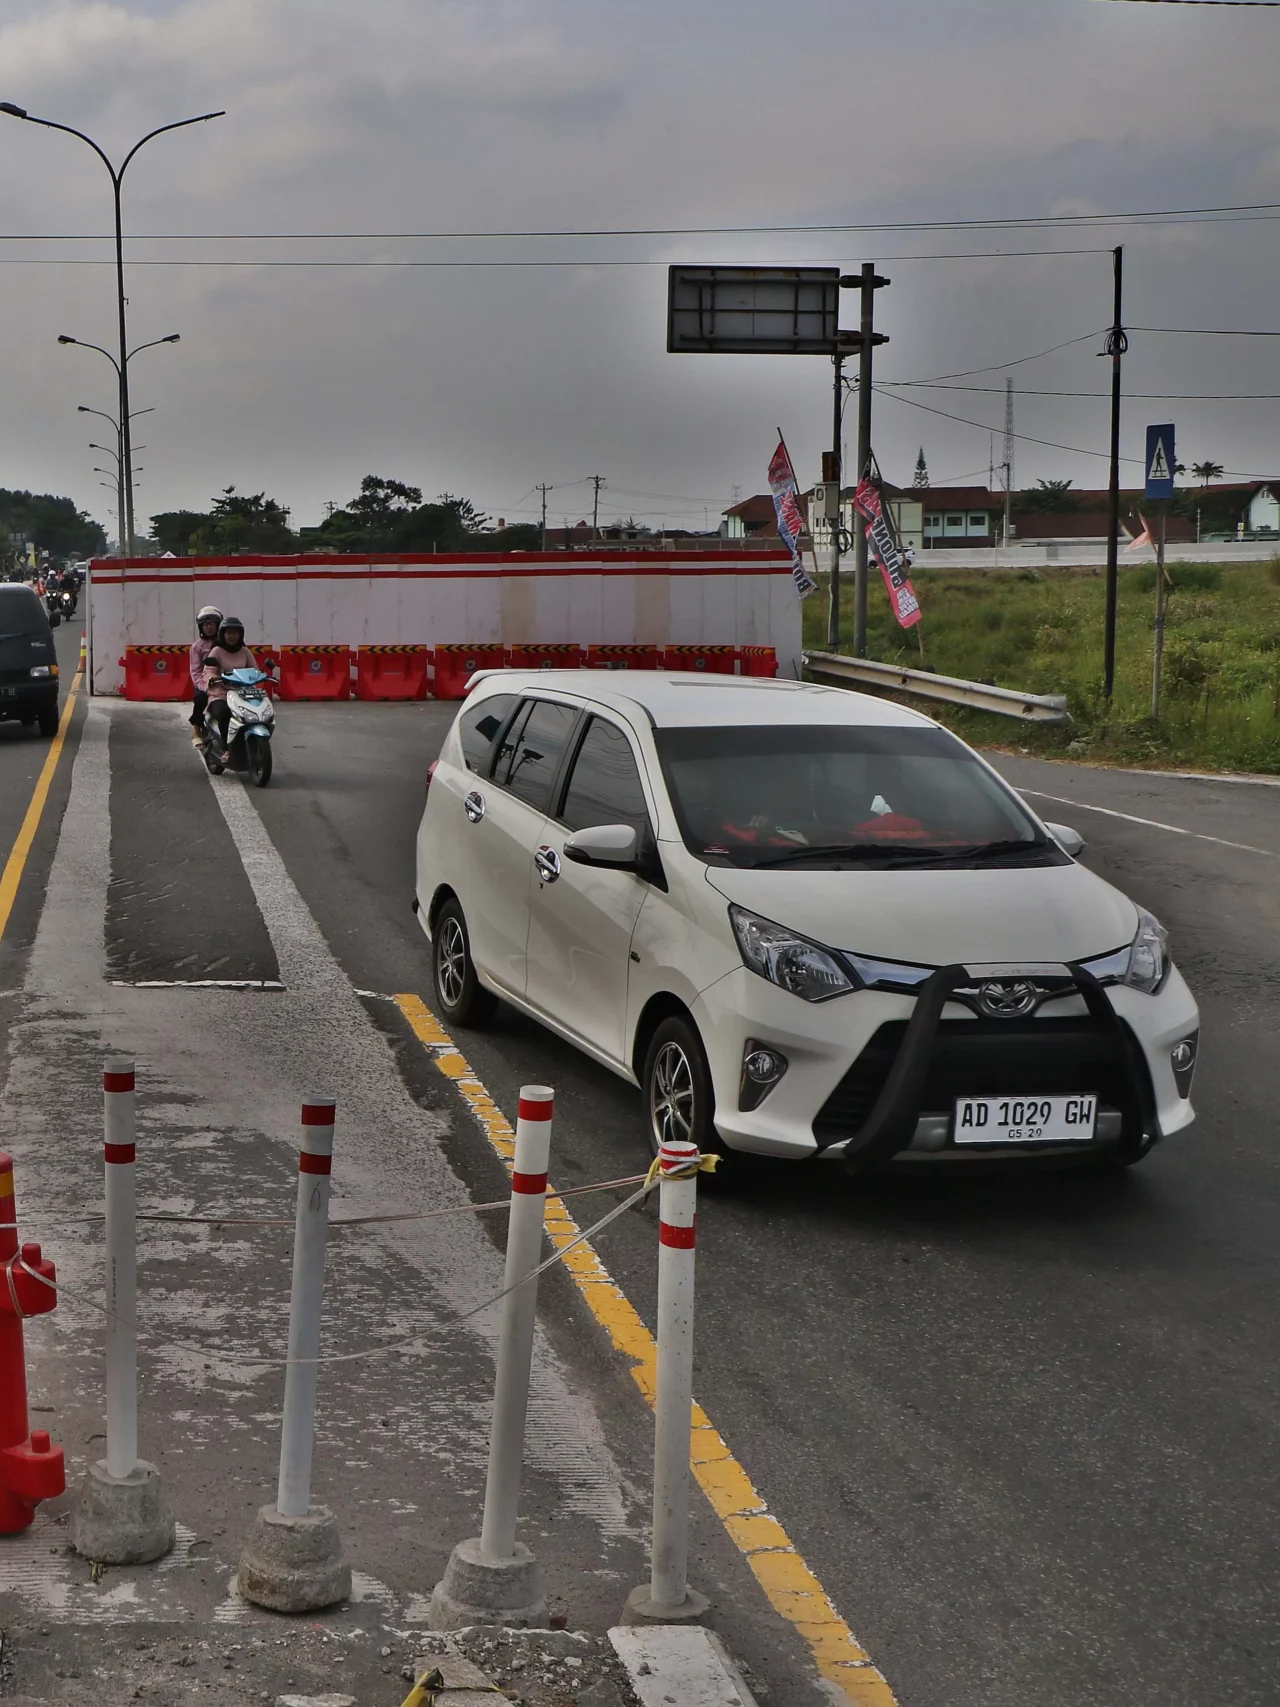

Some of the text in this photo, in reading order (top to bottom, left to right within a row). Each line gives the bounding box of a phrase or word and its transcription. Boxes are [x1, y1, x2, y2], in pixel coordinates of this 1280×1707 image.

[961, 1100, 1092, 1127] AD 1029 GW
